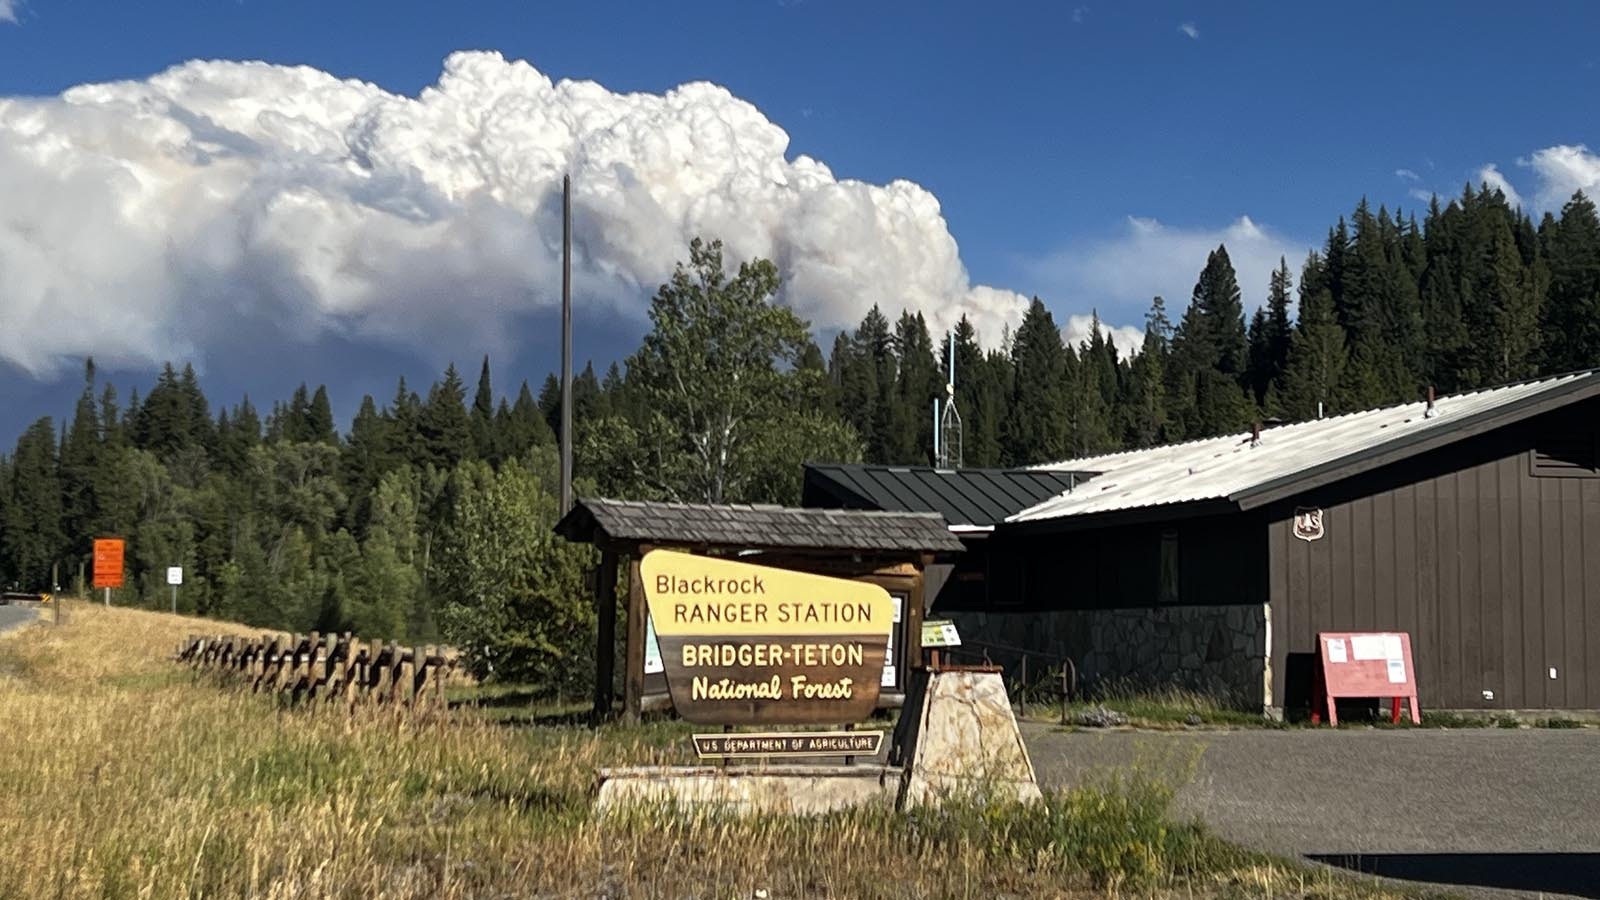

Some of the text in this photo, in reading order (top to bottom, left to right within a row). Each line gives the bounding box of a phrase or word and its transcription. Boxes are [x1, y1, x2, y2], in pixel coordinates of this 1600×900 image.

[656, 575, 765, 594] Blackrock
[674, 604, 768, 623] RANGER
[778, 603, 872, 623] STATION
[682, 644, 863, 666] BRIDGER-TETON
[692, 674, 853, 700] National Forest
[724, 739, 787, 752] DEPARTMENT
[792, 739, 803, 750] OF
[809, 737, 874, 750] AGRICULTURE
